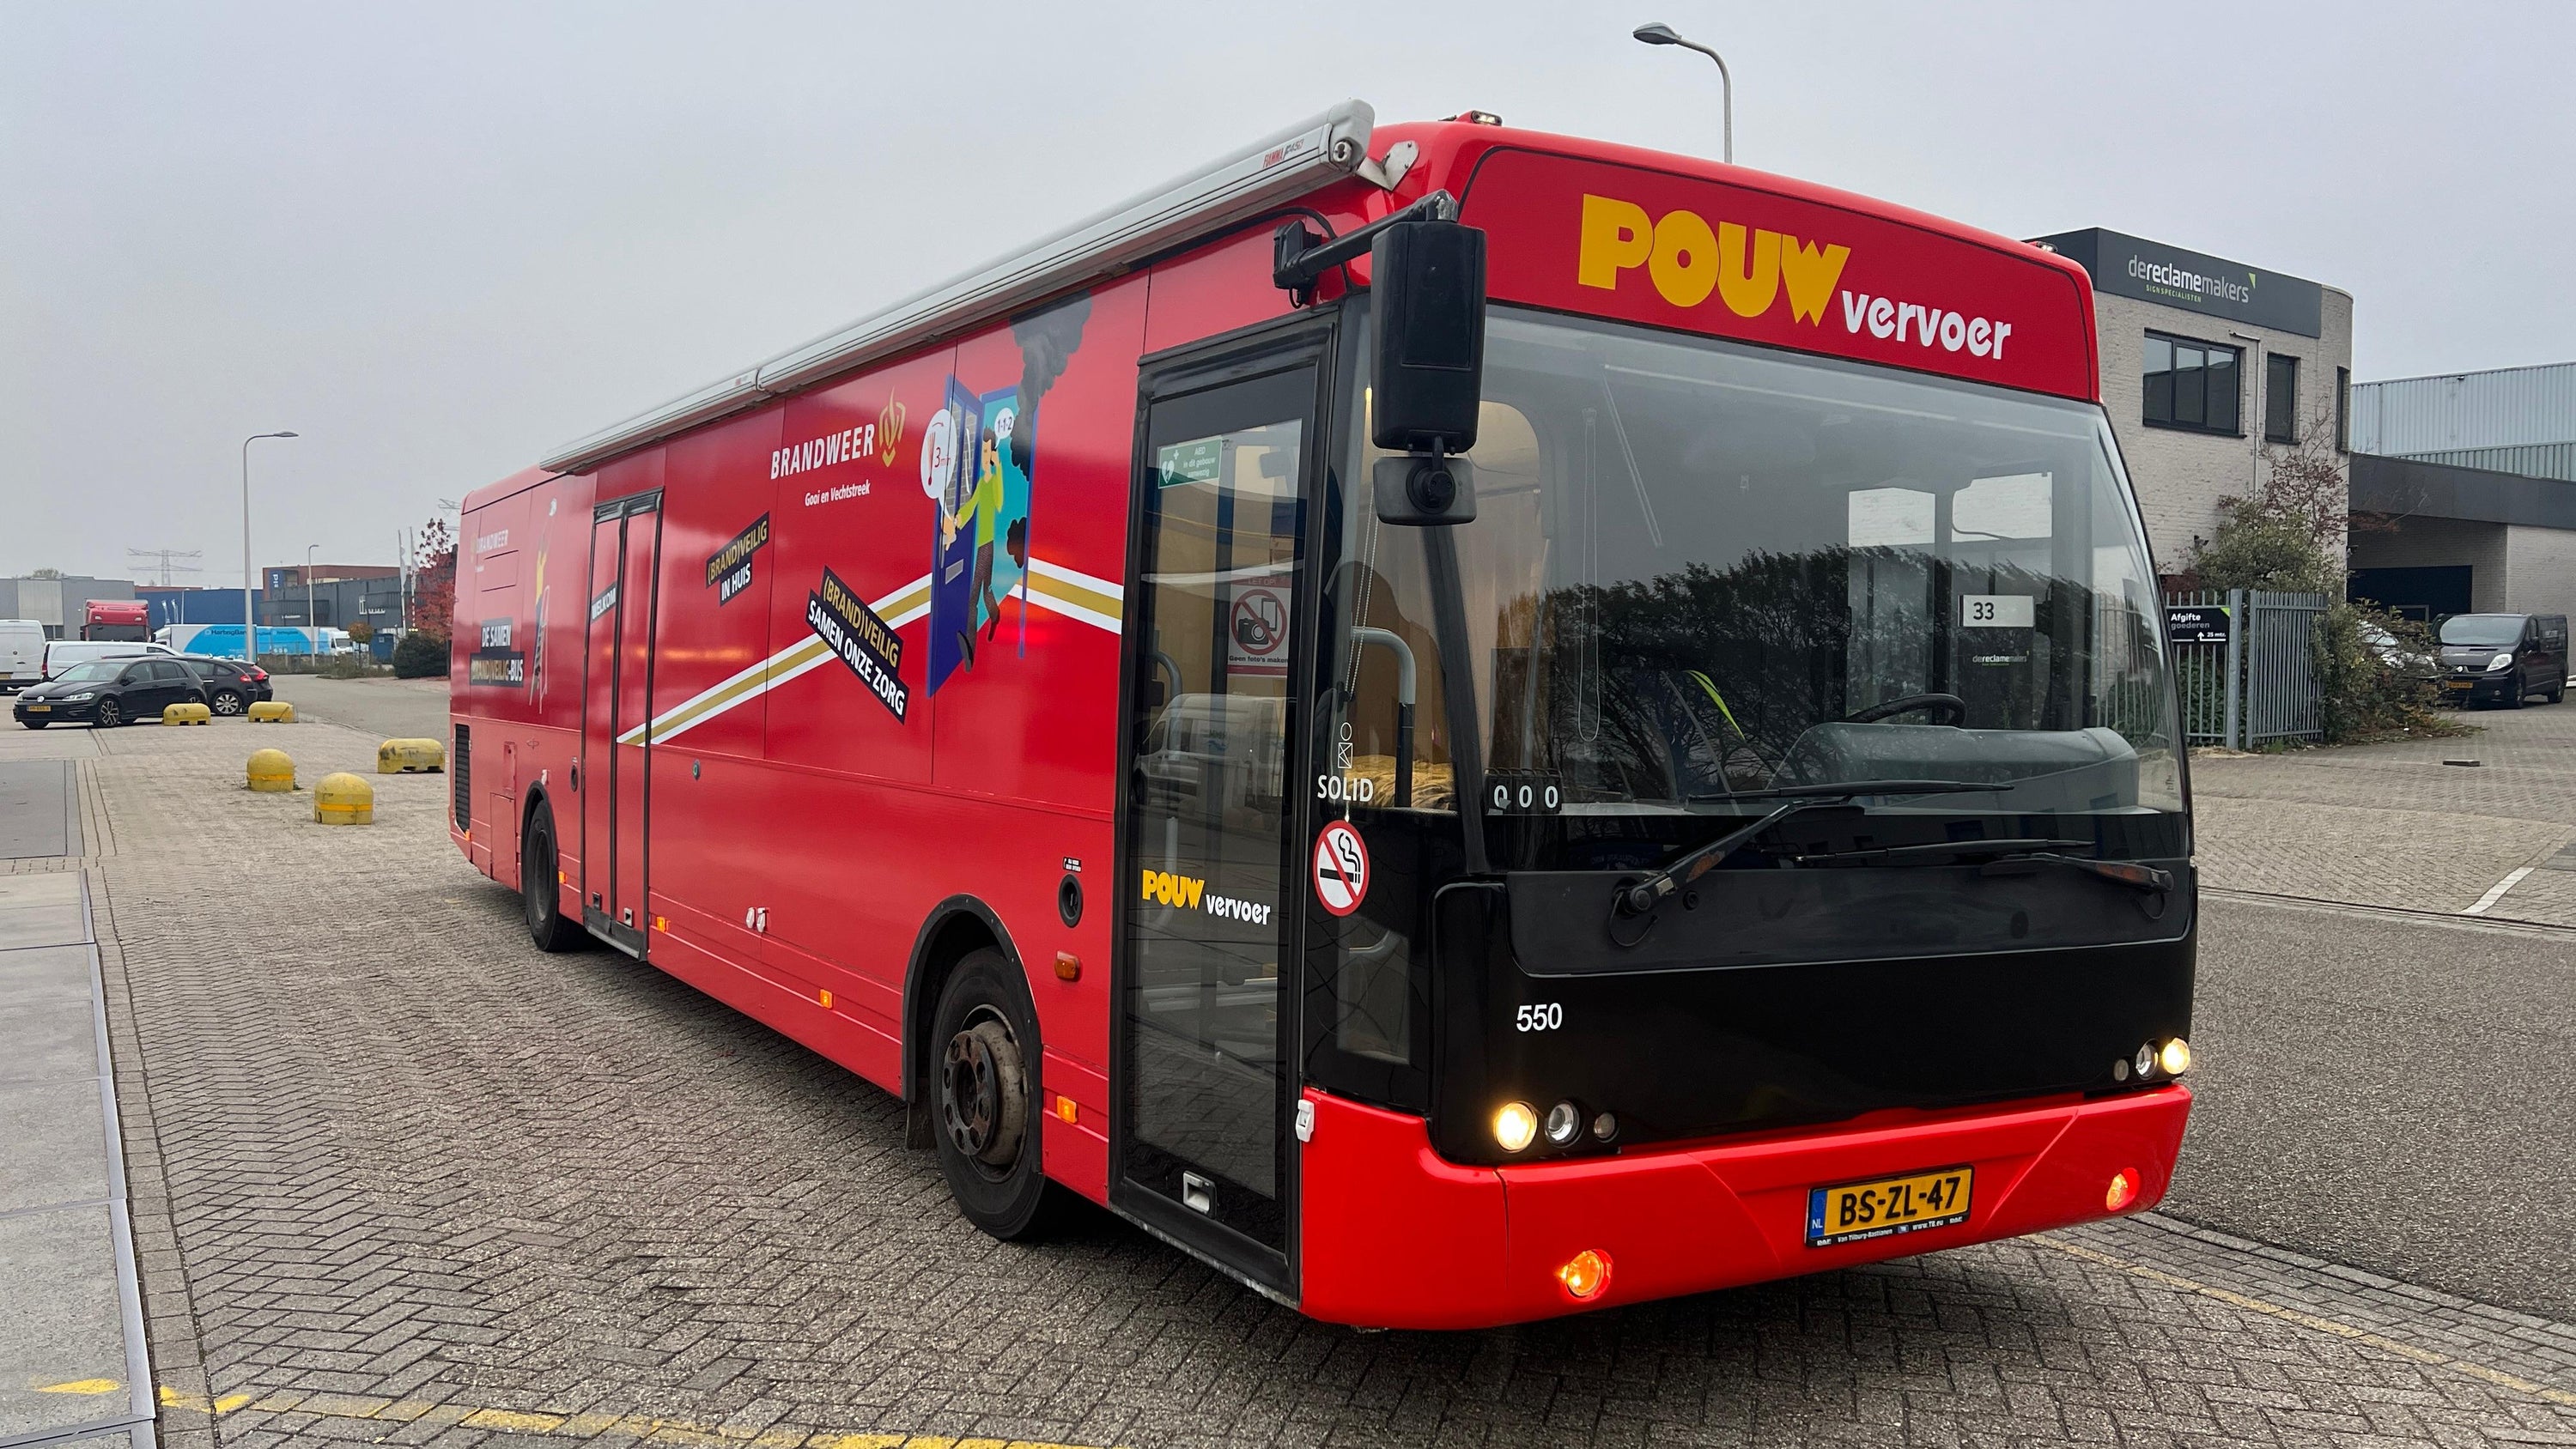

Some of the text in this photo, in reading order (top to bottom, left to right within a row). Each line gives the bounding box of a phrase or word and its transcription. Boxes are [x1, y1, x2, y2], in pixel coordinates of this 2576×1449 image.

[1578, 194, 2012, 360] POUW vervoer
[2128, 255, 2249, 303] dereclamemakers
[770, 423, 875, 480] BRANDWEER
[1194, 446, 1206, 456] AED
[805, 479, 871, 506] Gooi en Vechtstreek
[708, 520, 767, 585] (BRAND)VEILIG
[721, 562, 750, 601] IN HUIS
[592, 587, 616, 620] WELKOM
[1973, 602, 1994, 620] 33
[2171, 613, 2202, 623] Afgifte
[482, 624, 512, 647] DE SAMEN
[823, 575, 899, 668] (BRAND)VEILIG
[2171, 622, 2210, 631] goederen
[808, 599, 905, 715] SAMEN ONZE ZORG
[1317, 774, 1374, 803] SOLID
[1142, 869, 1271, 925] POUW vervoer
[1516, 1003, 1563, 1032] 550
[1839, 1177, 1961, 1227] BS-ZL-47
[1812, 1219, 1823, 1229] NL
